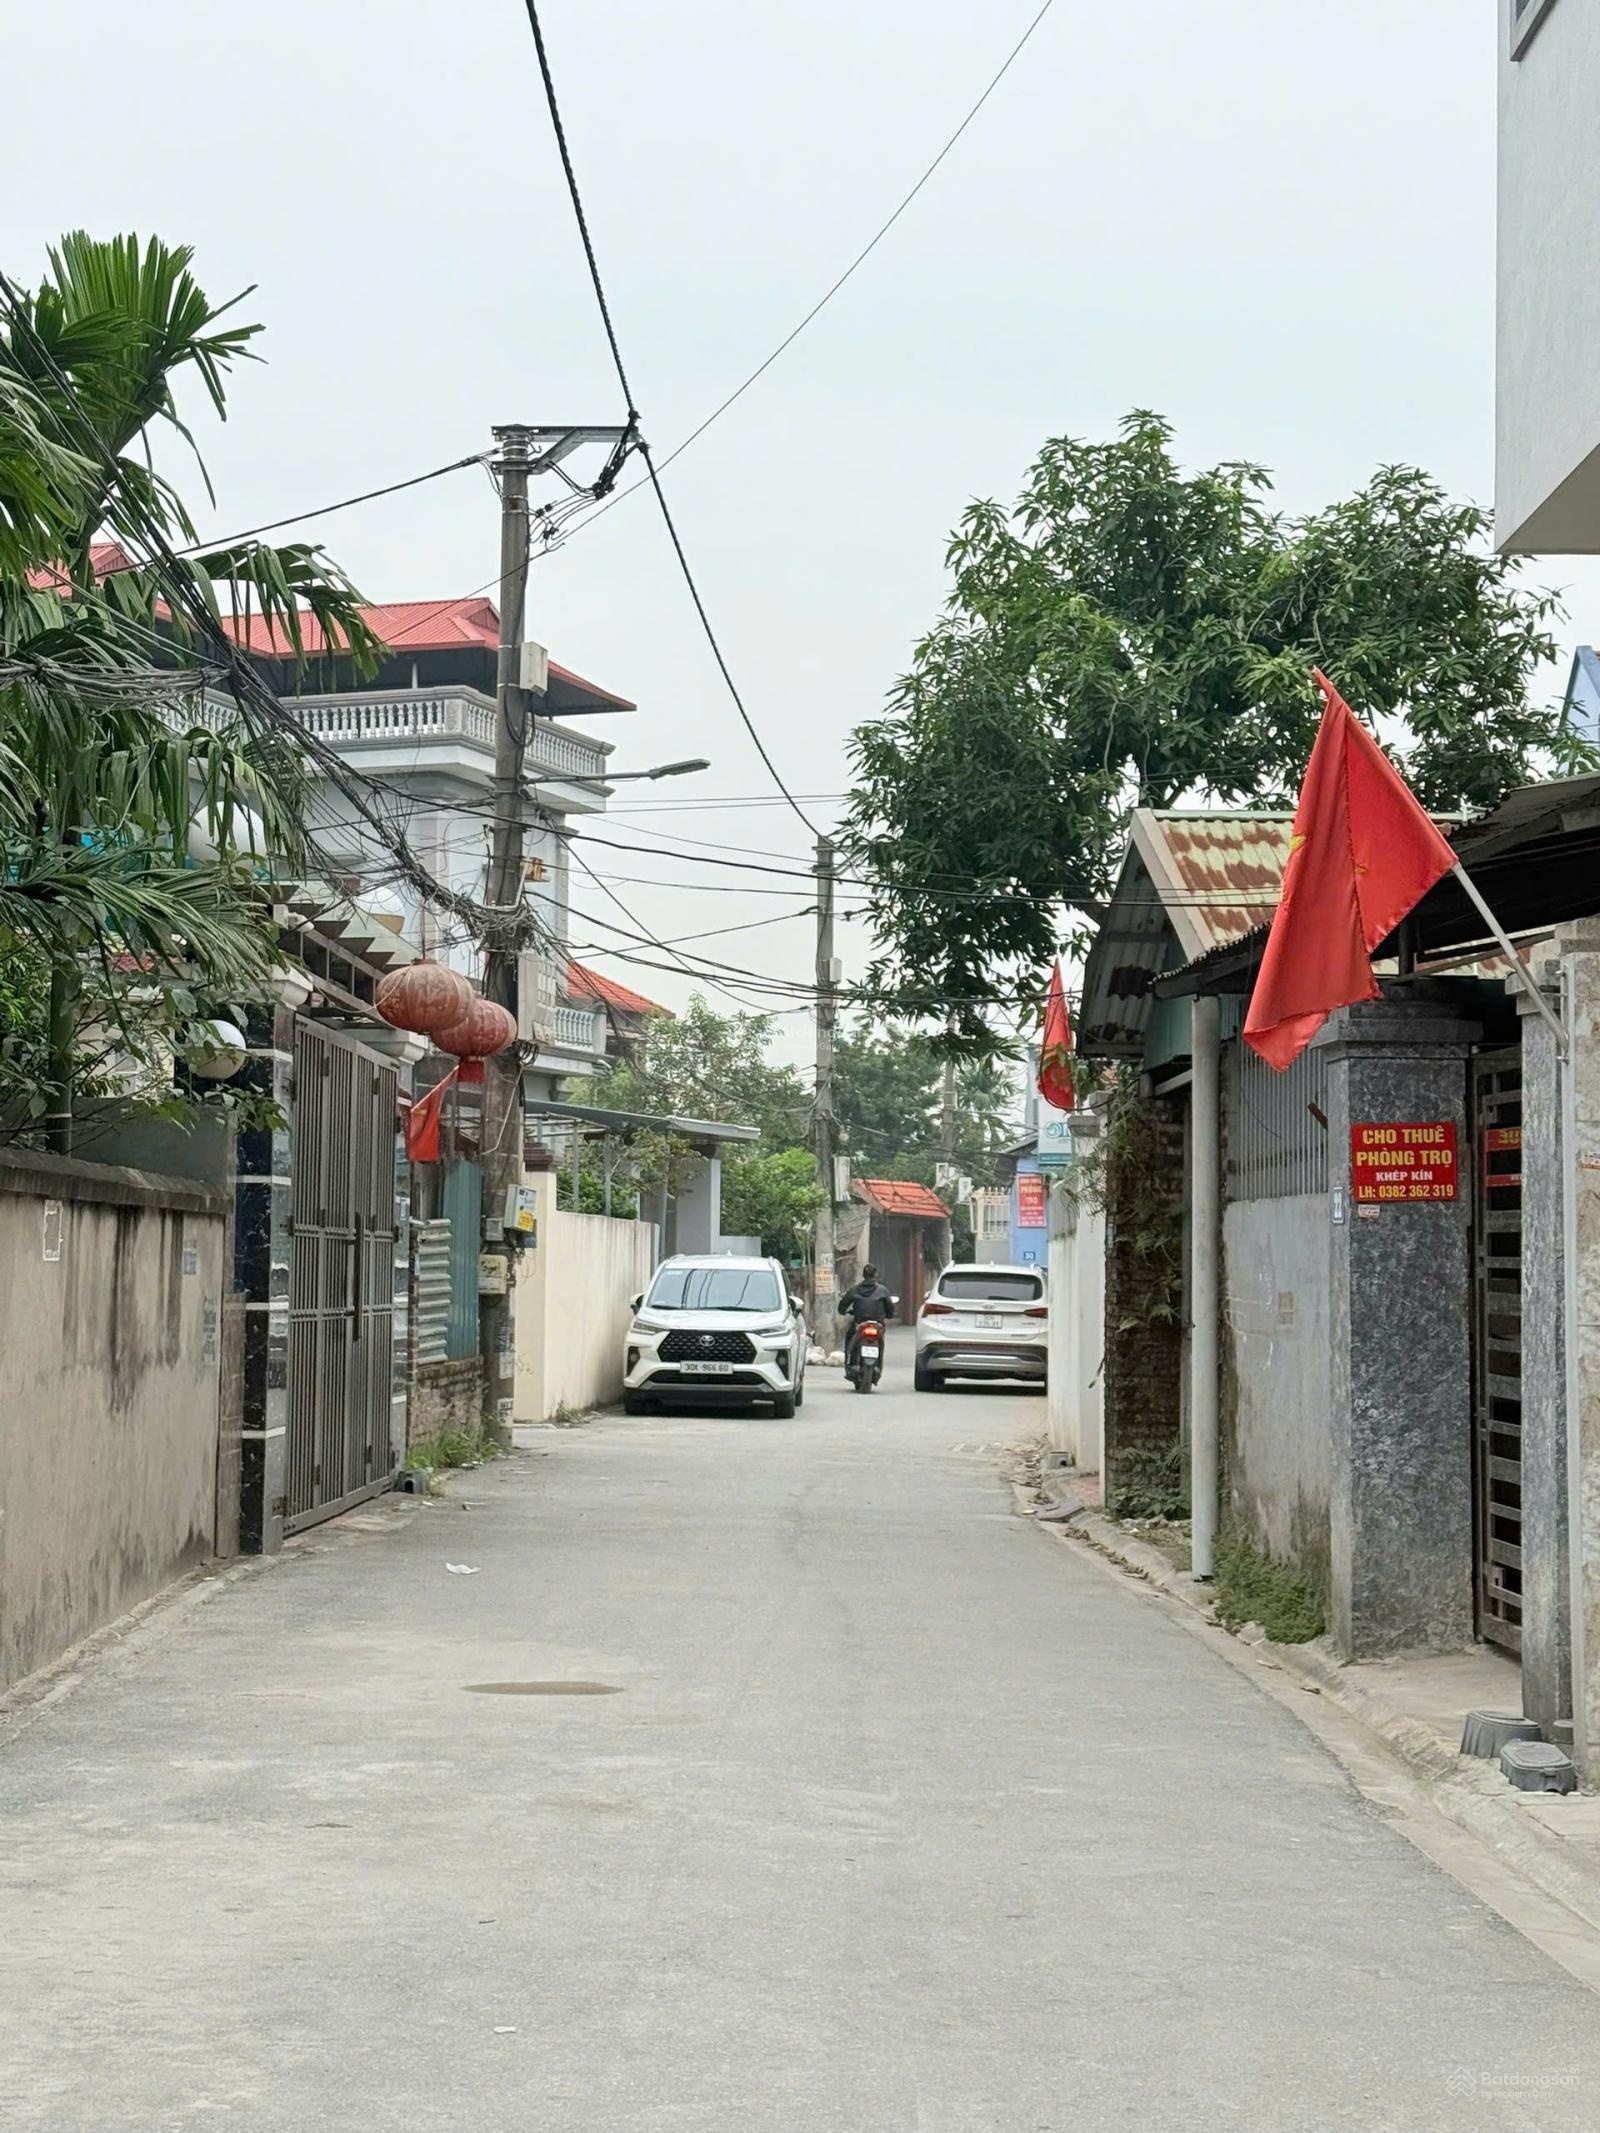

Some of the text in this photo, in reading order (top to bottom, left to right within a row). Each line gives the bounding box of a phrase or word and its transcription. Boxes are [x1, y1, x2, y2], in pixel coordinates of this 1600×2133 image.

[1362, 1125, 1445, 1144] CHO THUÊ
[1356, 1147, 1452, 1167] PHÒNG TRỌ
[1376, 1169, 1433, 1181] KHÉP KÍN
[1359, 1184, 1454, 1198] LH: 0382 362 319
